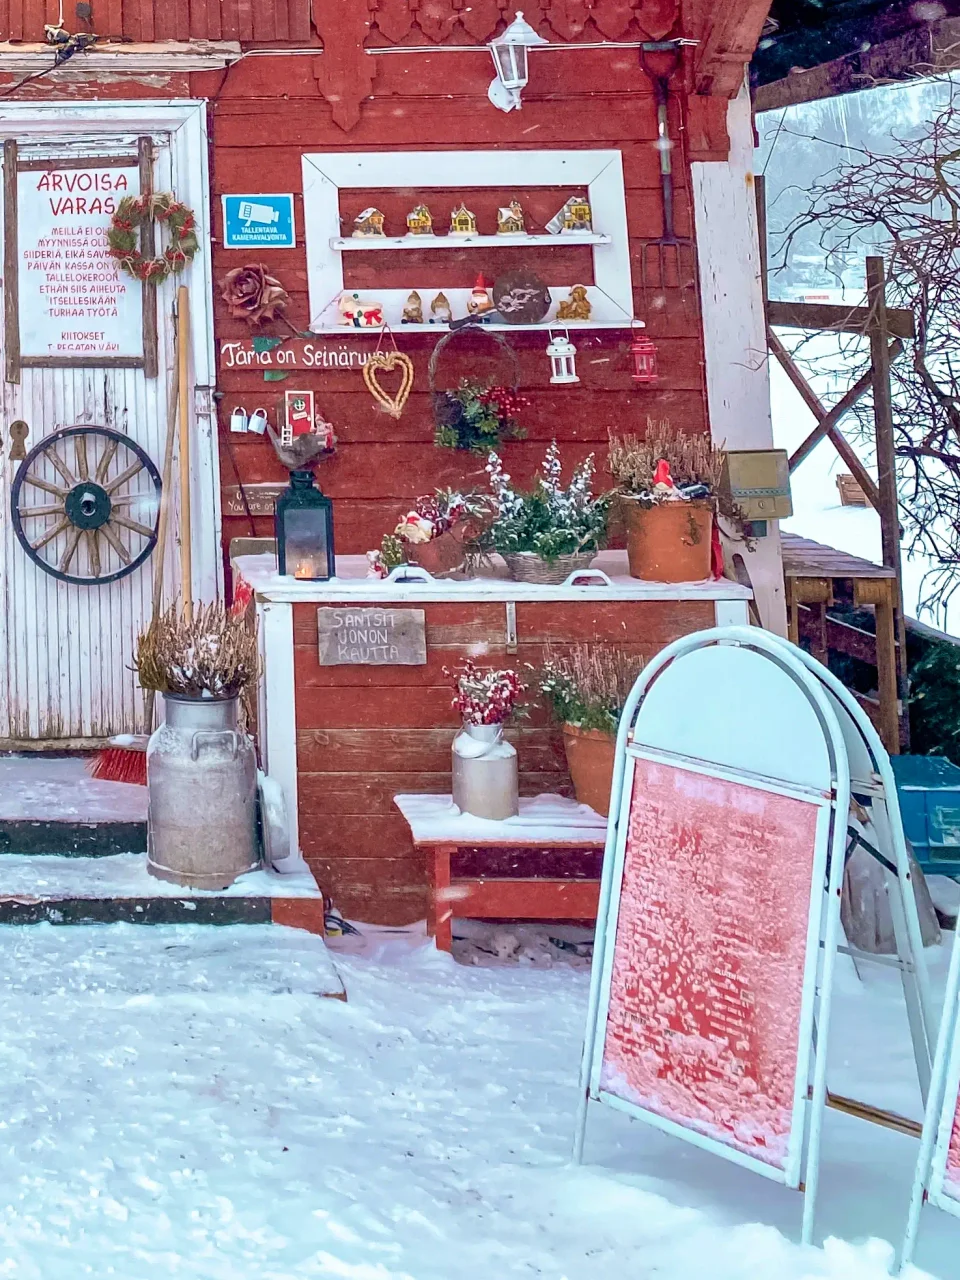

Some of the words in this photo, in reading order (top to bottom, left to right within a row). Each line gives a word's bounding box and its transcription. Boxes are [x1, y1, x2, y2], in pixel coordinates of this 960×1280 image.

[36, 173, 128, 192] ARVOISA
[49, 197, 116, 216] VARAS
[51, 226, 83, 236] MEILLÄ
[85, 227, 93, 236] EI
[240, 226, 278, 234] TALLENTAVA
[38, 237, 89, 248] MYYNNISSÄ
[65, 248, 85, 259] EIKÄ
[27, 260, 61, 271] PÄIVÄN
[64, 261, 94, 271] KASSA
[39, 284, 69, 294] ETHÄN
[70, 284, 88, 294] SIIS
[89, 284, 126, 294] AIHEUTA
[49, 295, 117, 305] ITSELLESIKÄÄN
[48, 308, 85, 317] TURHAA
[87, 307, 118, 317] TYÖTÄ
[61, 332, 105, 340] KIITOKSET
[276, 349, 297, 365] on
[331, 612, 397, 628] SANTSIT
[337, 629, 389, 644] JONON
[337, 646, 401, 661] KAUTTA
